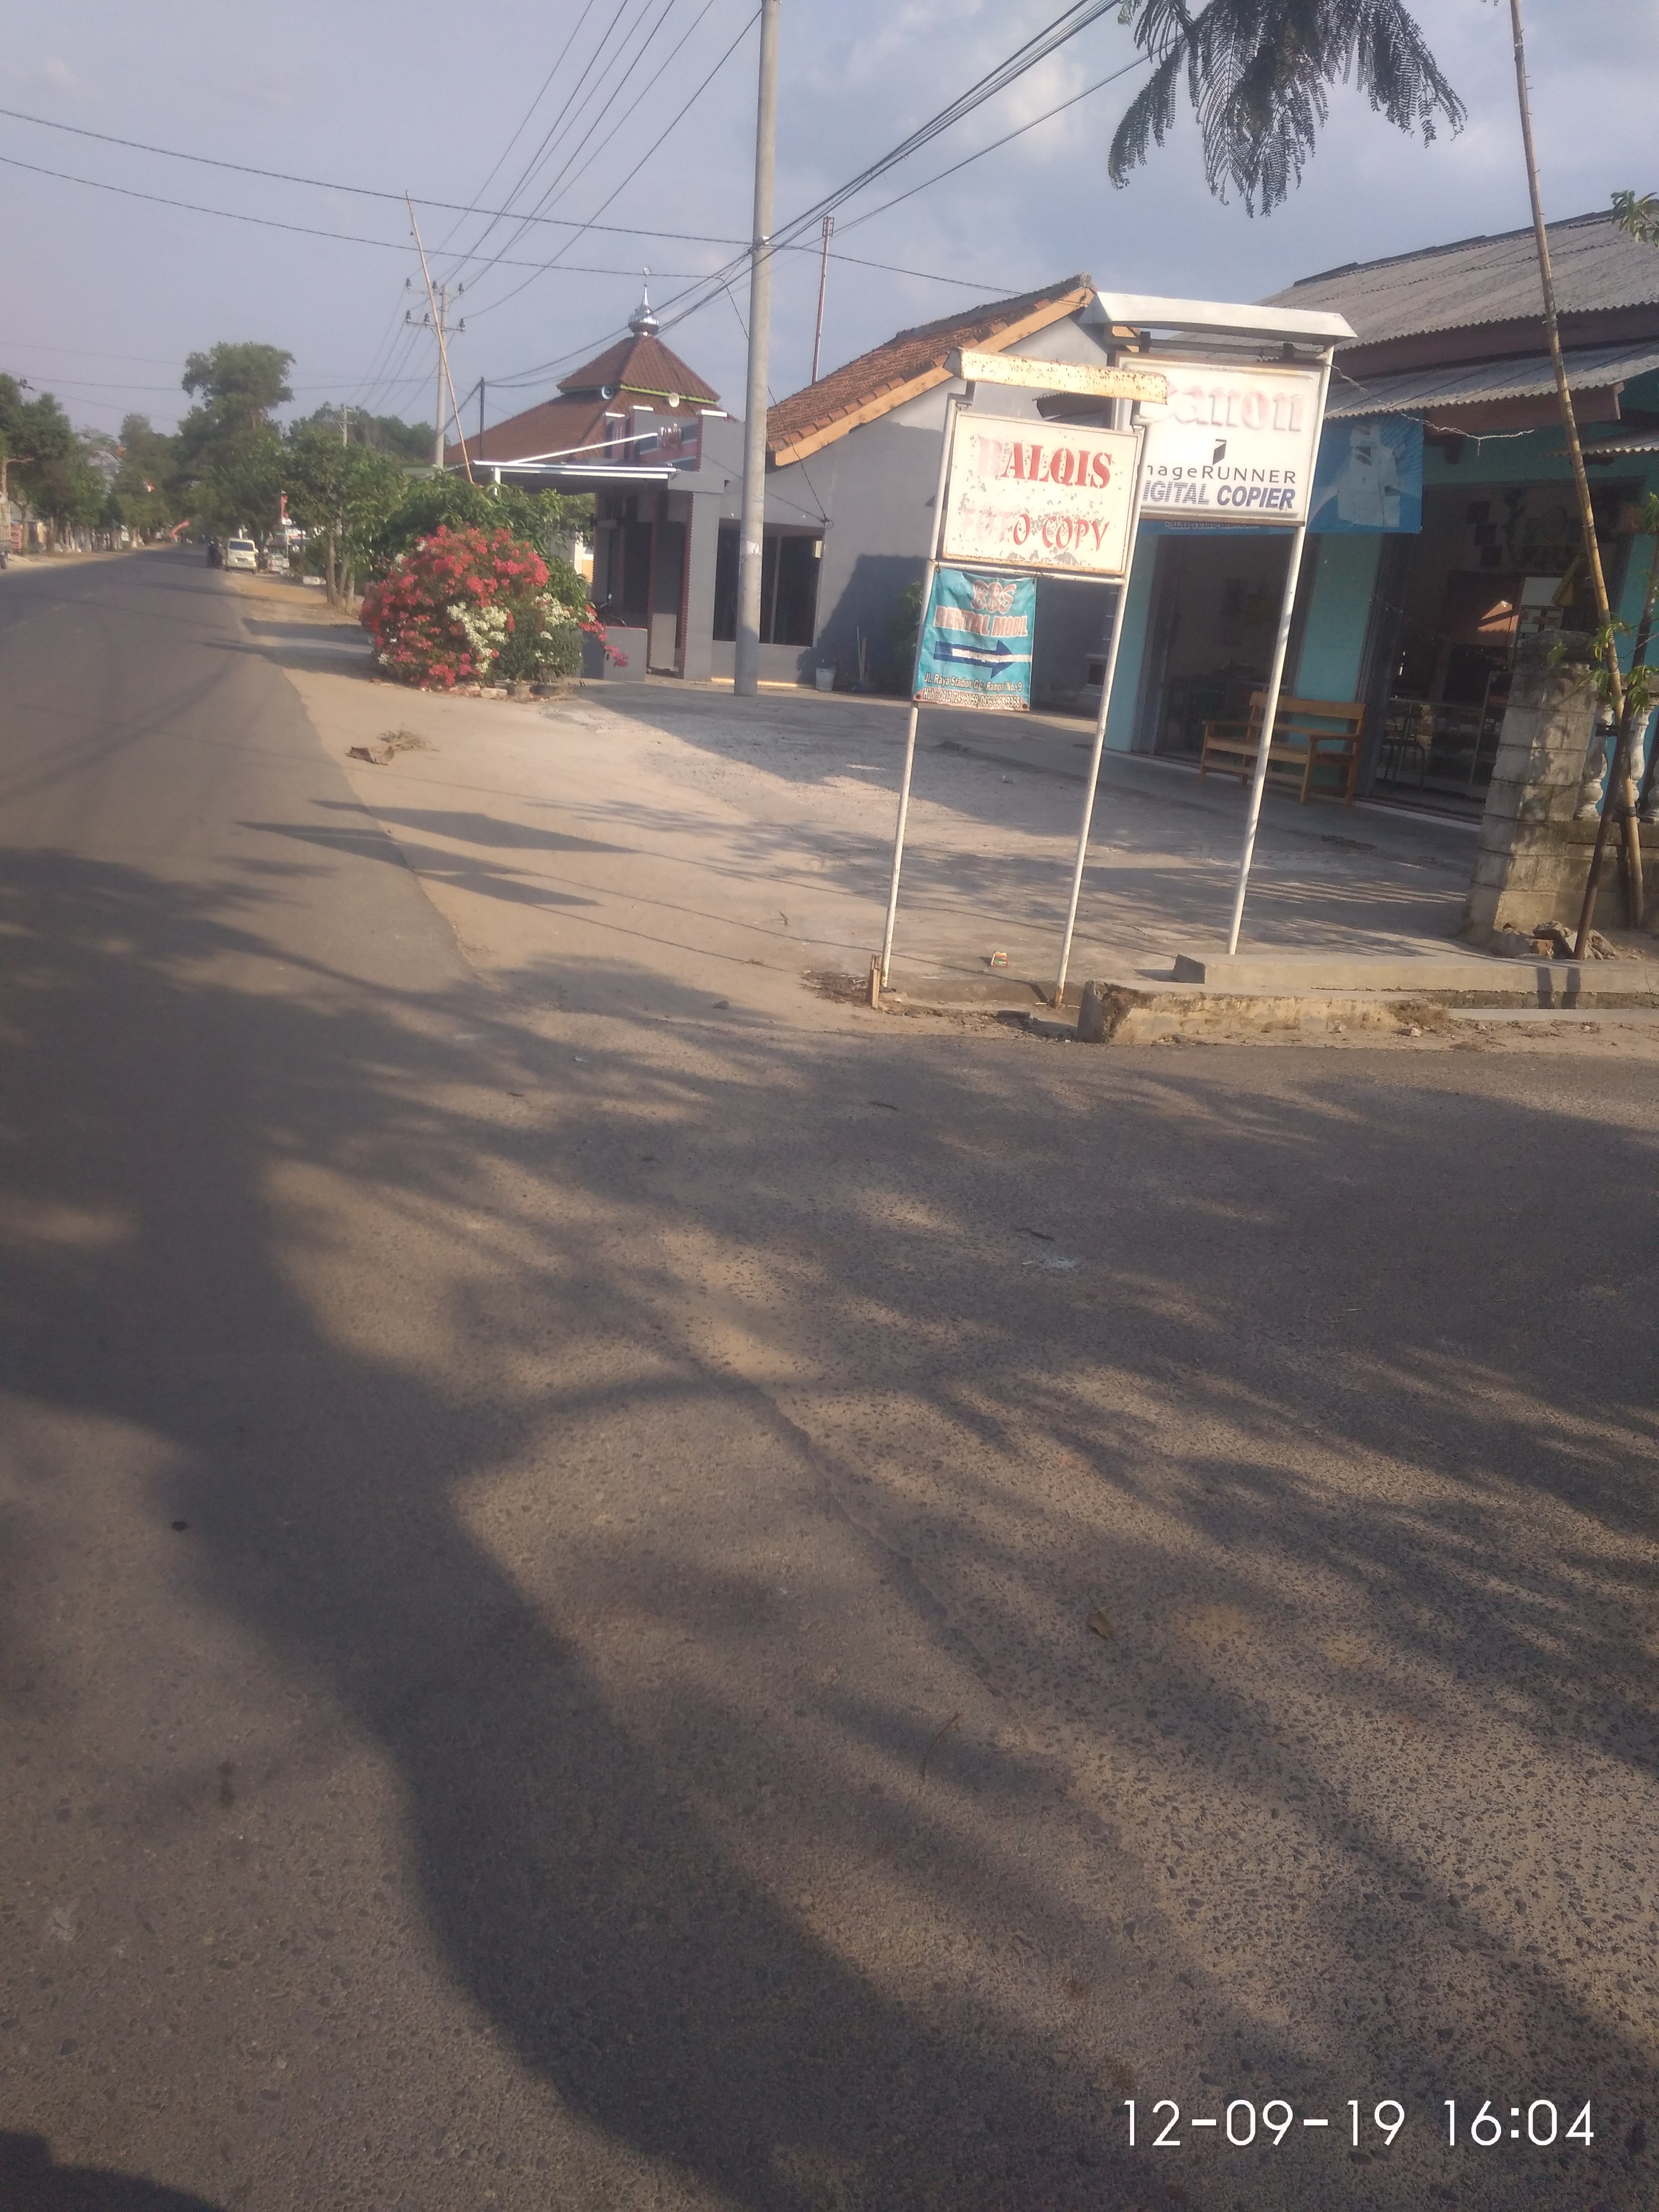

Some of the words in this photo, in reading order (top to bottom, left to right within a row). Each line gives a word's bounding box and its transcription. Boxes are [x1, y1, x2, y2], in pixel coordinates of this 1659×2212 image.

[977, 439, 1112, 489] BALQIS
[1146, 465, 1296, 484] ageRUNNER
[1143, 480, 1210, 505] IGITAL
[1217, 484, 1296, 510] COPIER
[1042, 515, 1110, 552] COPY
[971, 579, 1017, 614] BBS
[933, 605, 990, 636] RENTAL
[991, 615, 1028, 637] MOBIL
[934, 673, 950, 687] Raya
[951, 676, 971, 689] Stadion
[1006, 681, 1016, 692] No.
[1017, 681, 1023, 692] 9
[939, 690, 952, 702] 0812
